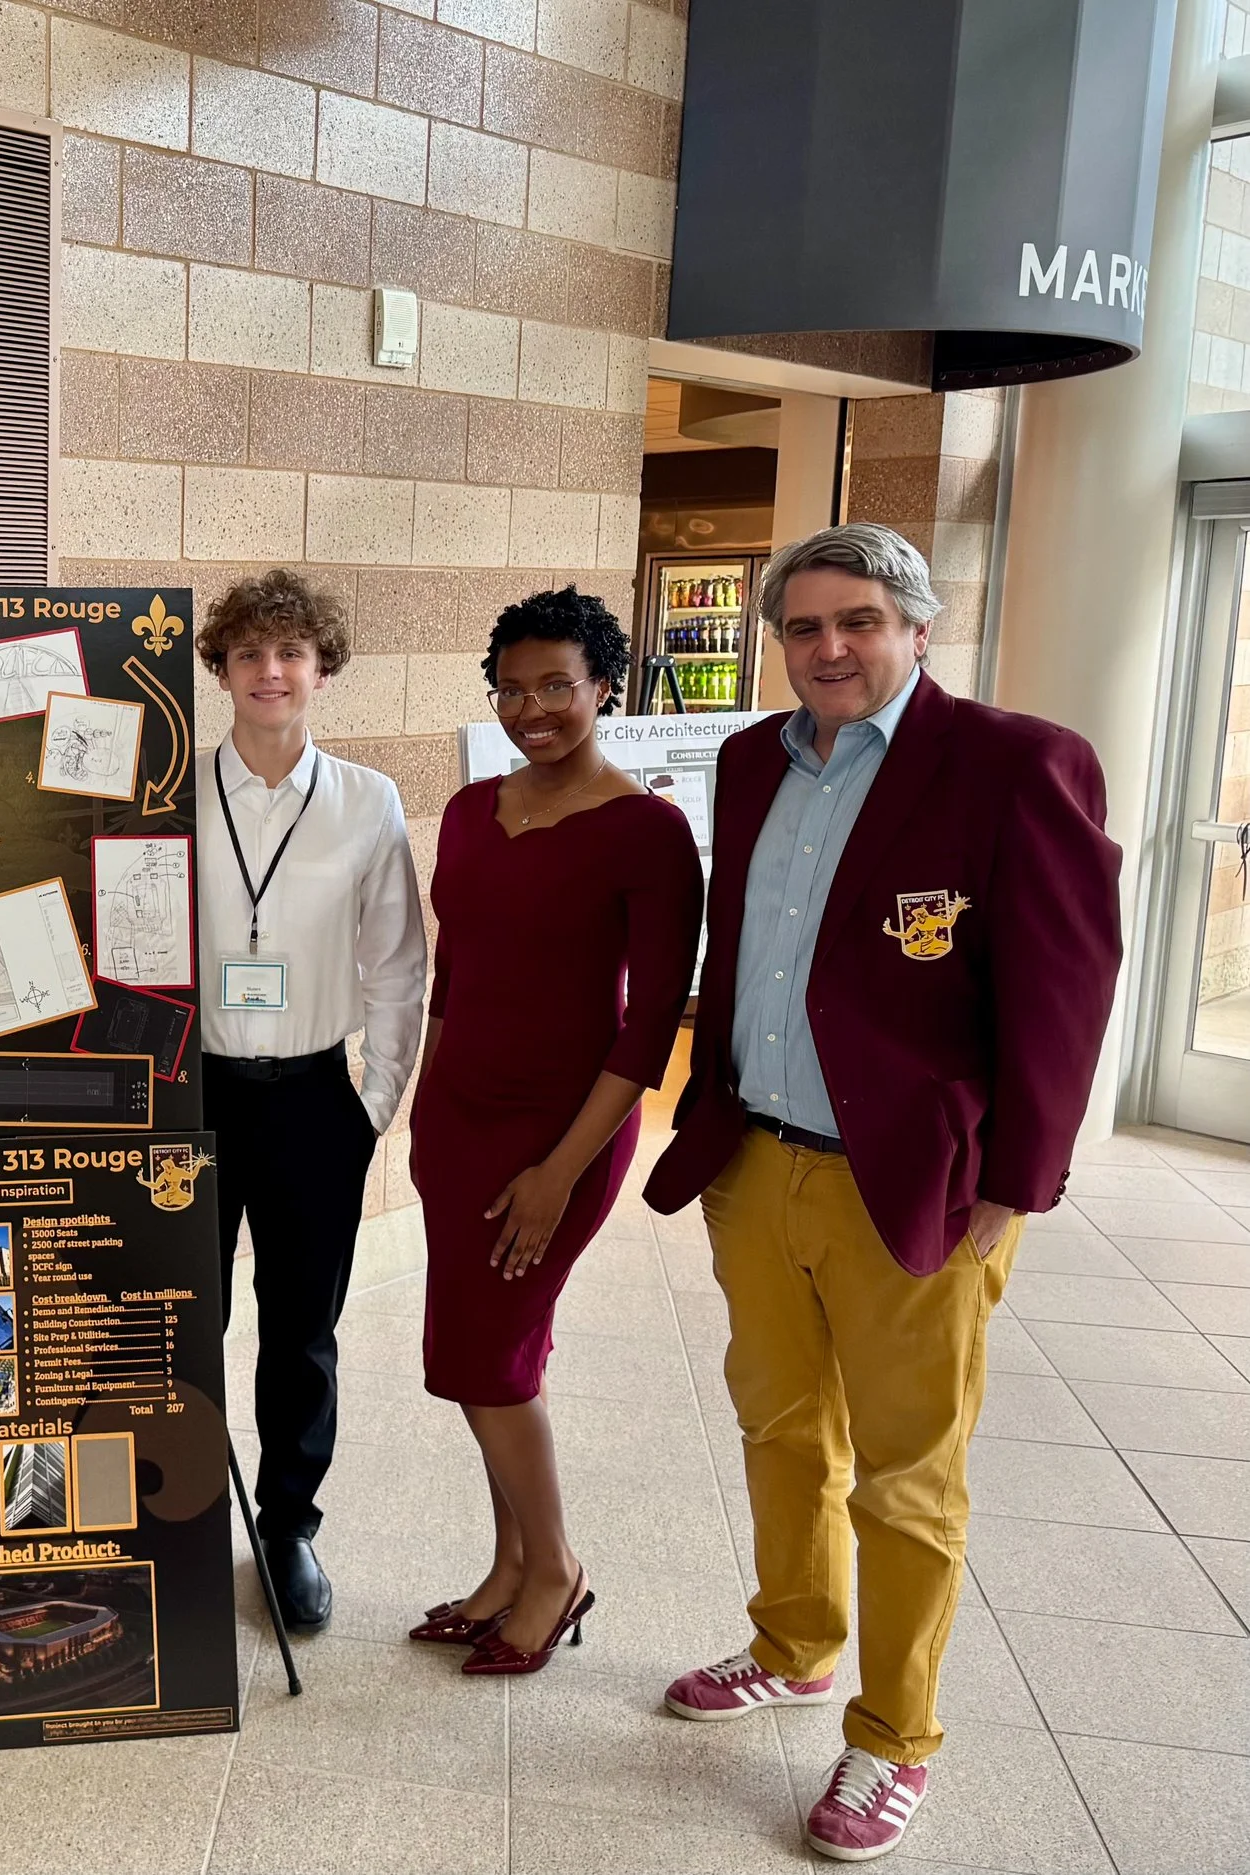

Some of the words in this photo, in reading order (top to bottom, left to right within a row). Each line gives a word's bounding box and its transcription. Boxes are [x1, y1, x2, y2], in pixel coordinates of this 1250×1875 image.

[34, 597, 121, 623] Rouge
[614, 724, 644, 742] City
[649, 720, 745, 738] Architectural
[25, 771, 36, 784] 4.
[81, 944, 91, 956] 6.
[177, 1070, 188, 1084] 8.
[2, 1149, 45, 1171] 313
[54, 1148, 143, 1173] Rouge
[23, 1217, 58, 1228] Design
[59, 1214, 111, 1227] spotlights
[31, 1230, 55, 1238] 15000
[56, 1229, 78, 1238] Seats
[31, 1240, 52, 1249] 2500
[53, 1240, 67, 1249] off
[67, 1239, 90, 1248] street
[91, 1238, 123, 1248] parking
[28, 1253, 55, 1262] spaces
[32, 1263, 54, 1271] DCFC
[55, 1262, 72, 1272] sign
[32, 1273, 51, 1282] Year
[52, 1272, 77, 1281] round
[78, 1273, 92, 1281] use
[32, 1294, 53, 1304] Cost
[54, 1292, 107, 1303] breakdown
[120, 1291, 141, 1300] Cost
[143, 1290, 153, 1299] in
[155, 1288, 193, 1298] millions
[32, 1307, 56, 1316] Demo
[57, 1306, 73, 1315] and
[164, 1302, 173, 1310] 15
[33, 1320, 67, 1330] Building
[165, 1315, 178, 1324] 125
[33, 1333, 49, 1341] Site
[51, 1333, 69, 1342] Prep
[71, 1332, 77, 1340] &
[165, 1329, 174, 1337] 16
[33, 1344, 84, 1355] Professional
[166, 1341, 174, 1349] 16
[34, 1359, 62, 1367] Permit
[166, 1354, 172, 1362] 5
[34, 1371, 63, 1381] Zoning
[167, 1367, 172, 1375] 3
[35, 1384, 73, 1393] Furniture
[75, 1383, 90, 1391] and
[168, 1392, 176, 1400] 18
[129, 1404, 153, 1415] Total
[166, 1403, 184, 1413] 207
[38, 1540, 121, 1561] Product:
